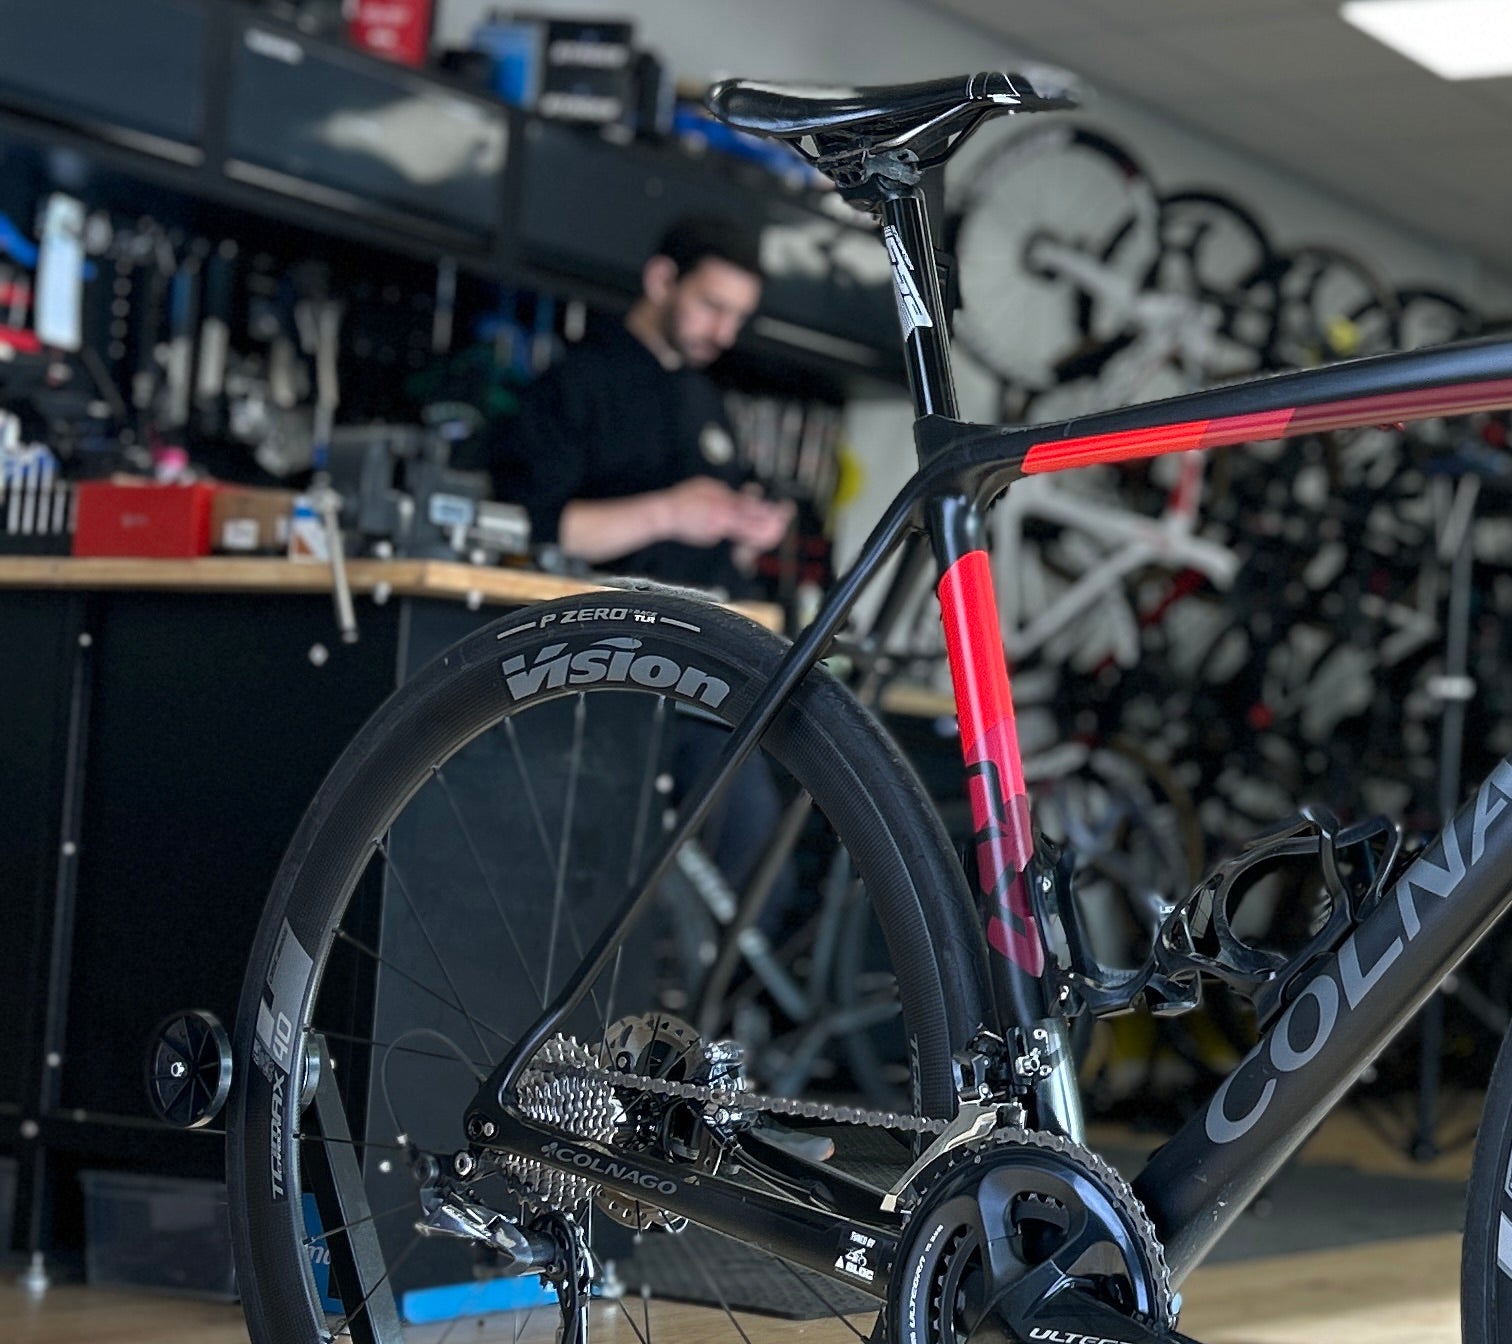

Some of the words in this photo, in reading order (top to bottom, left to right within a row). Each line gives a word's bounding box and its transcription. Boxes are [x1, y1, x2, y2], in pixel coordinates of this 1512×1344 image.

[540, 613, 557, 629] P
[560, 607, 628, 624] ZERO
[501, 637, 731, 709] Vision
[272, 1011, 293, 1062] 40
[555, 1147, 678, 1195] COLNAGO
